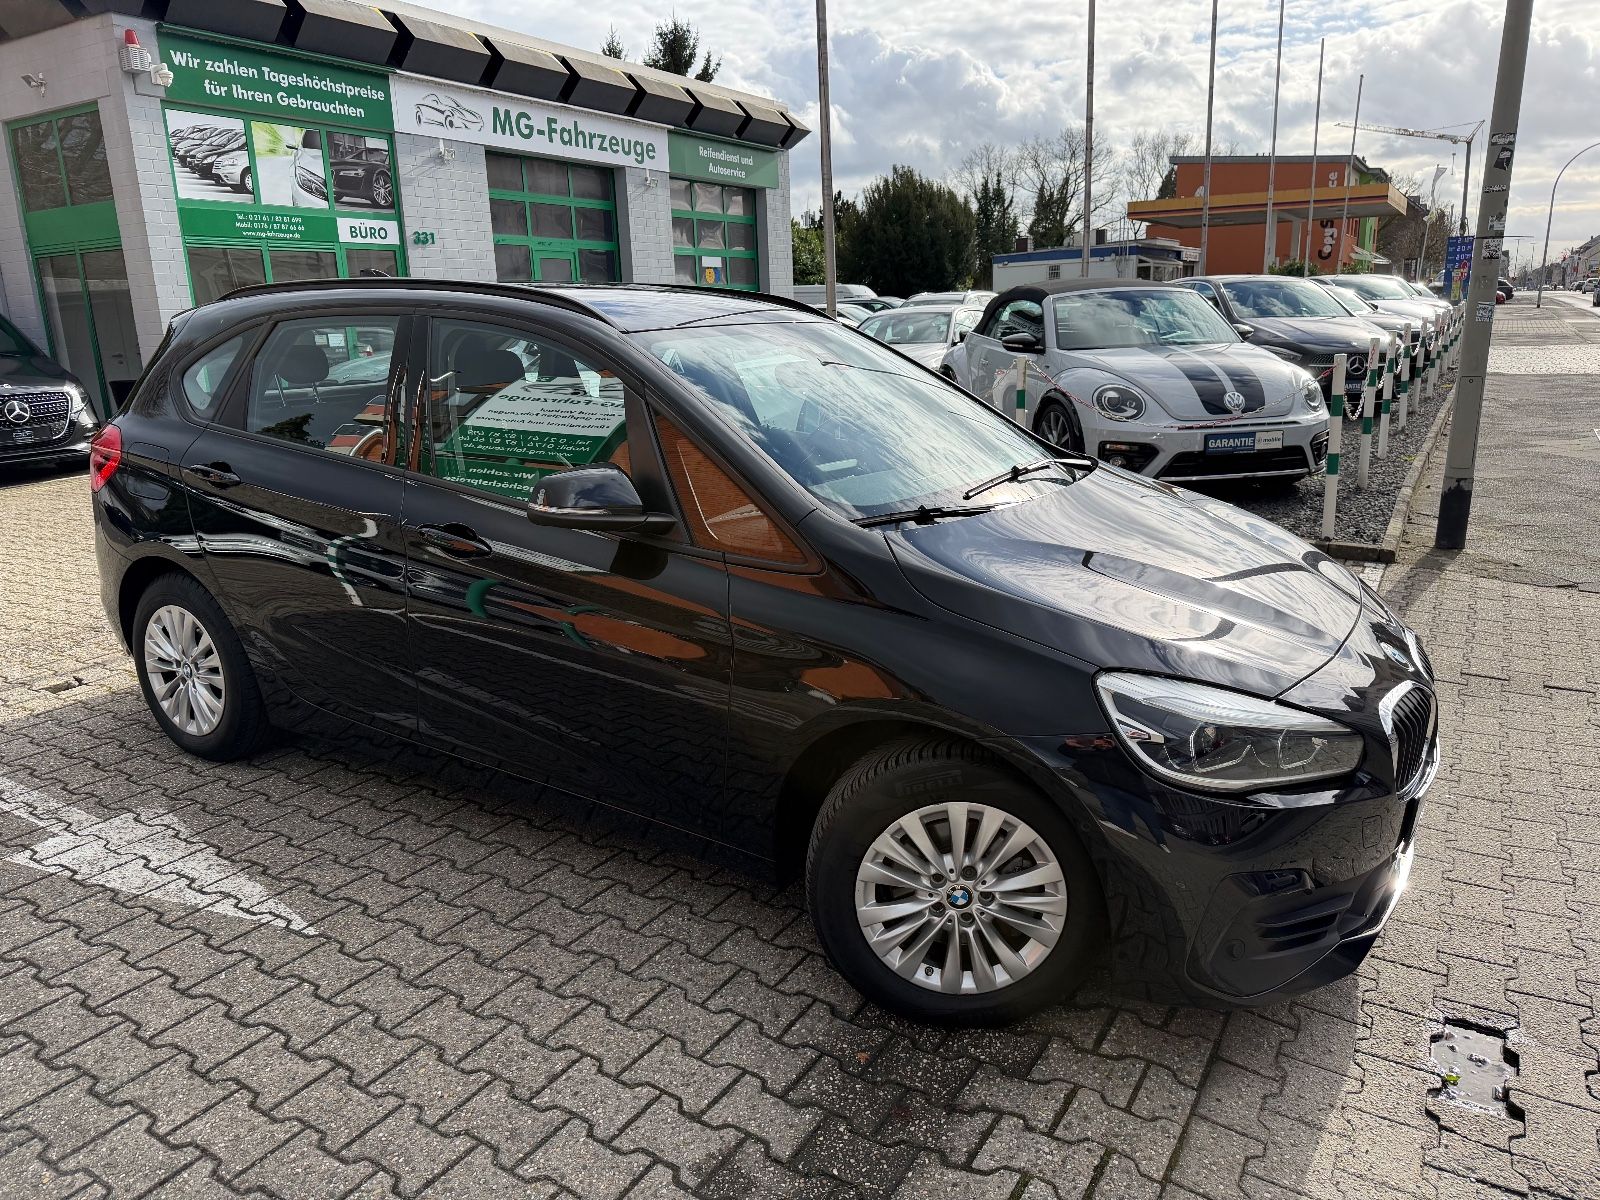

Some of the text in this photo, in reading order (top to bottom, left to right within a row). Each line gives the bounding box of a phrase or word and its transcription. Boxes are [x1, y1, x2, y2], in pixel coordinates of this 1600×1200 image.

[170, 49, 385, 101] Wir zahlen Tageshöchstpreise
[204, 79, 365, 118] für Ihren Gebrauchten
[492, 106, 656, 164] MG-Fahrzeuge
[699, 146, 753, 166] Reifendienst und
[708, 162, 746, 178] Autoservice
[242, 230, 301, 239] www.mg-fahrzeuge.de
[349, 222, 388, 240] BÜRO
[413, 230, 436, 245] 331
[1208, 437, 1255, 448] GARANTIE
